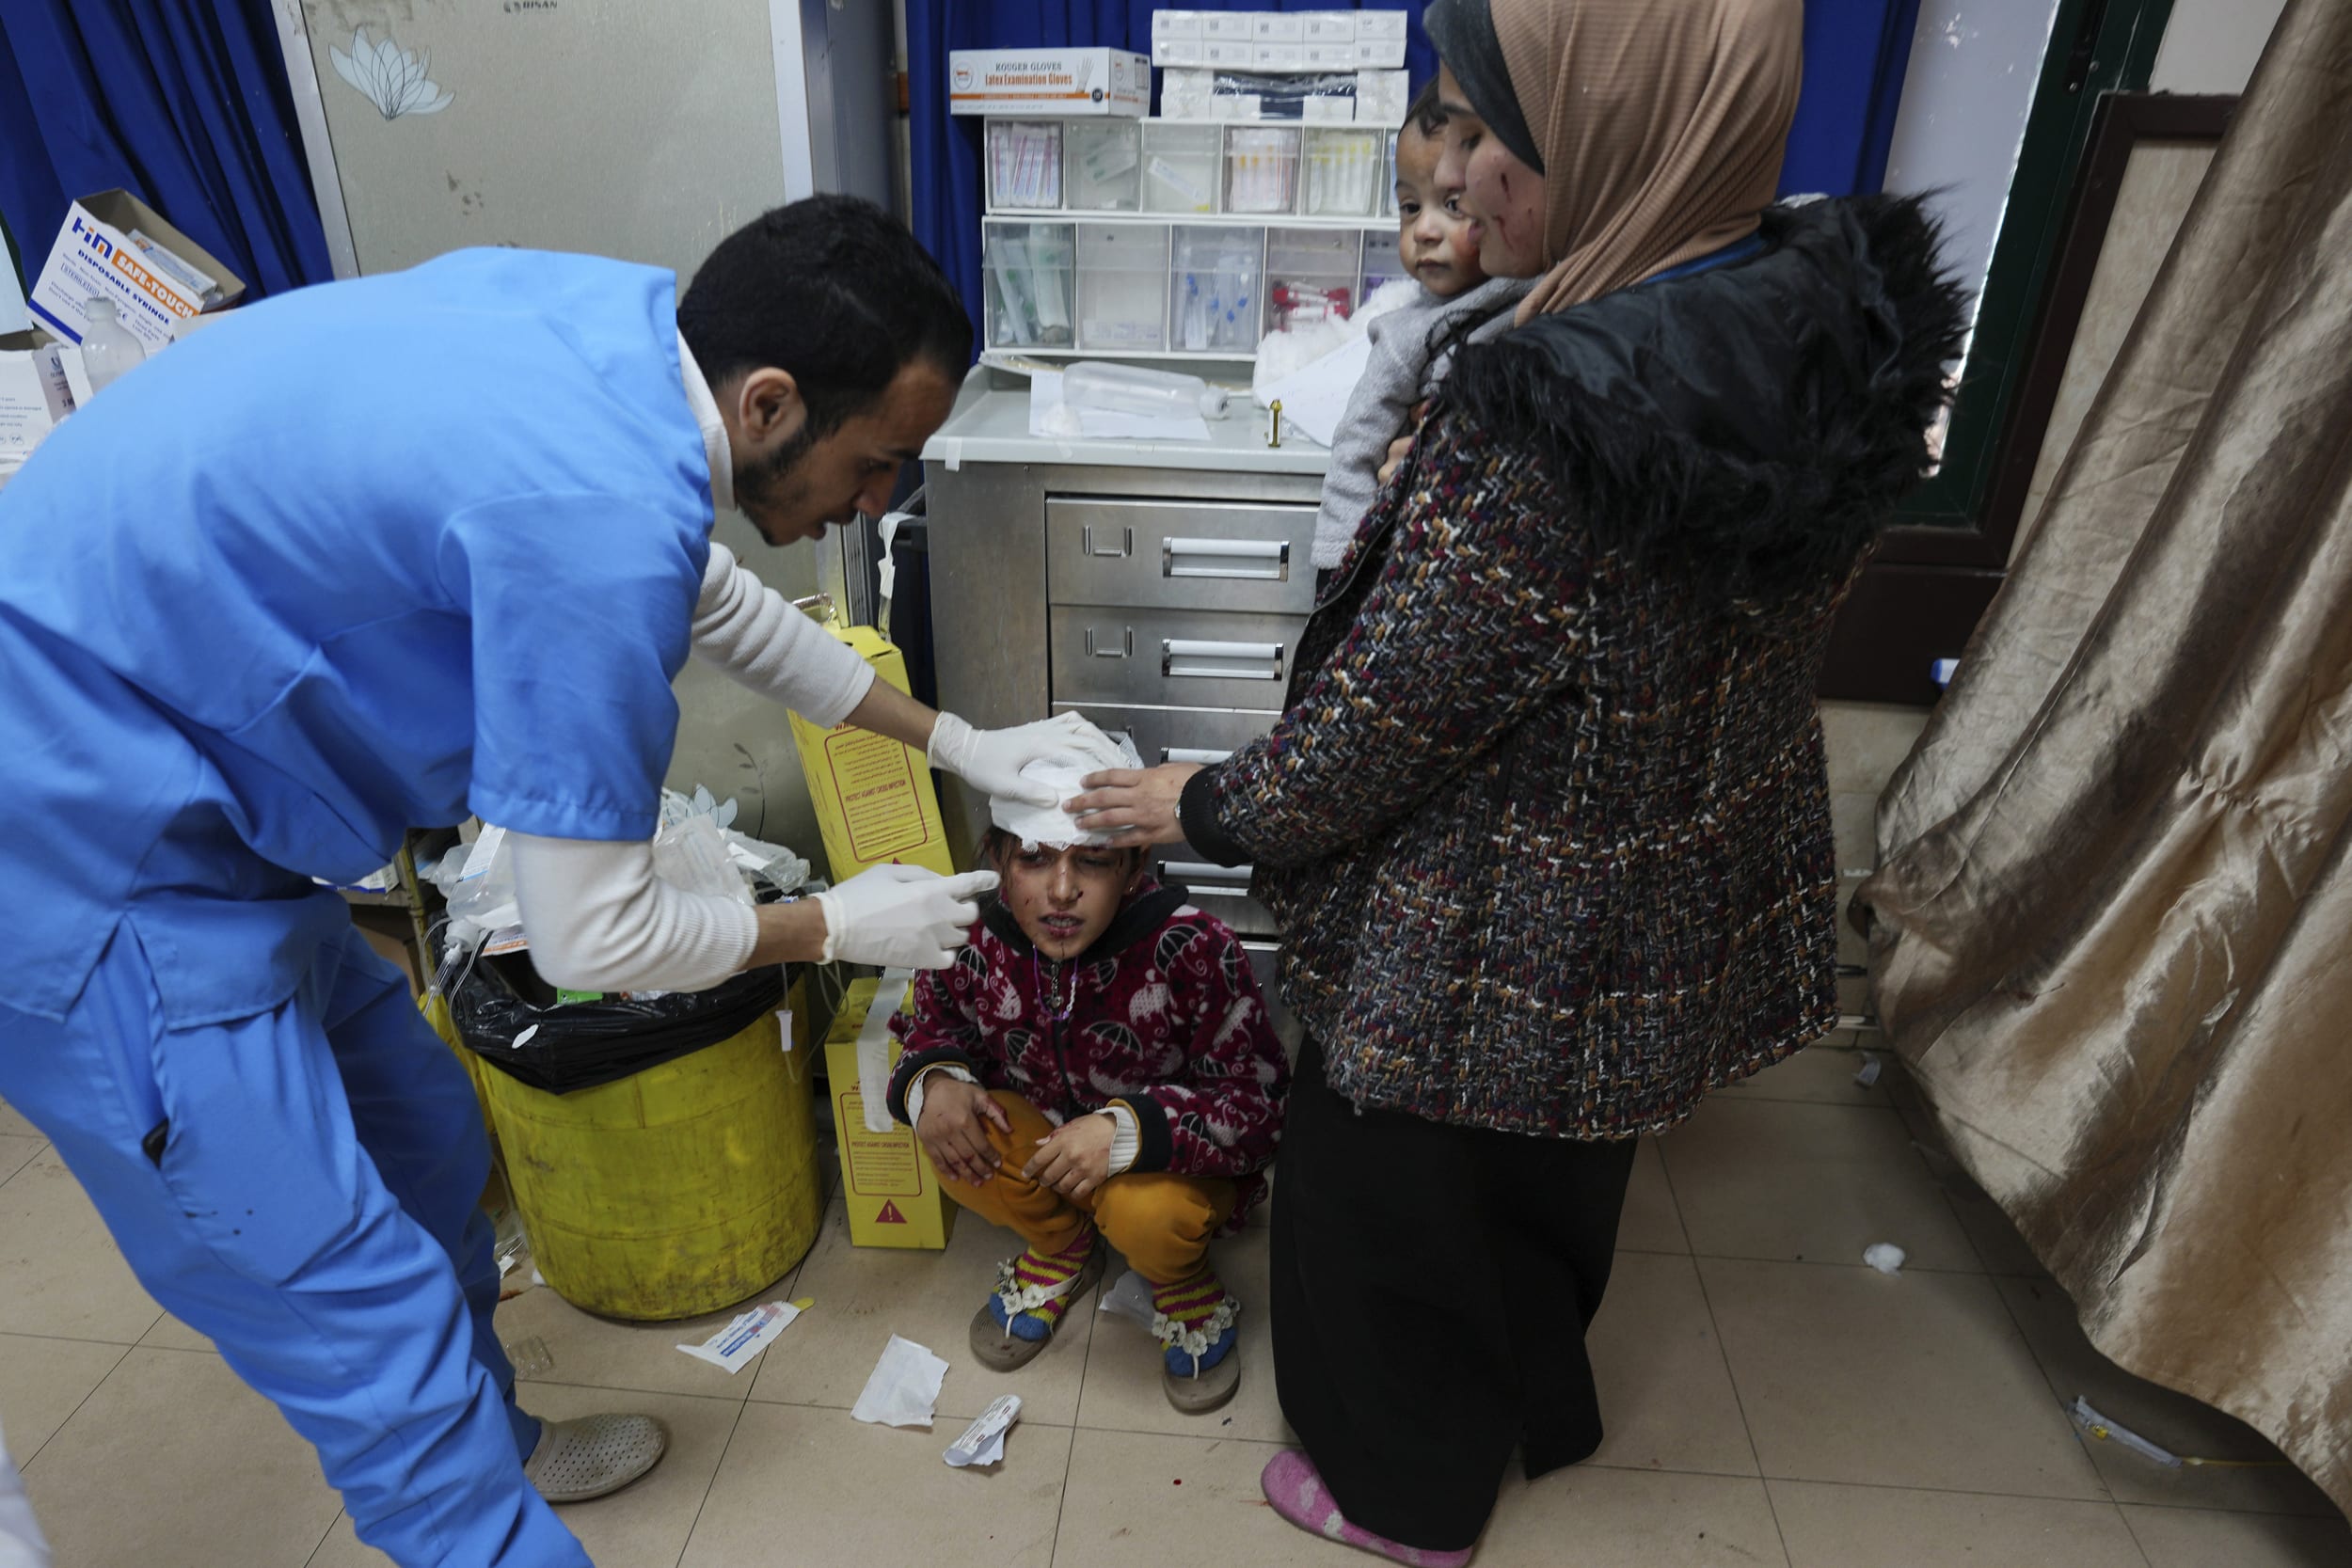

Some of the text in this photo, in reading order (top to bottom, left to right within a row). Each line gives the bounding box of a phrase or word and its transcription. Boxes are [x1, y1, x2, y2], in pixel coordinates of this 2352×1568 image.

[1030, 61, 1062, 71] GLOVES
[985, 74, 1004, 87] Latex
[1004, 74, 1047, 86] Examination
[1048, 73, 1073, 86] Gloves
[77, 249, 131, 294] DISPOSABLE
[132, 293, 170, 326] SYRINGE
